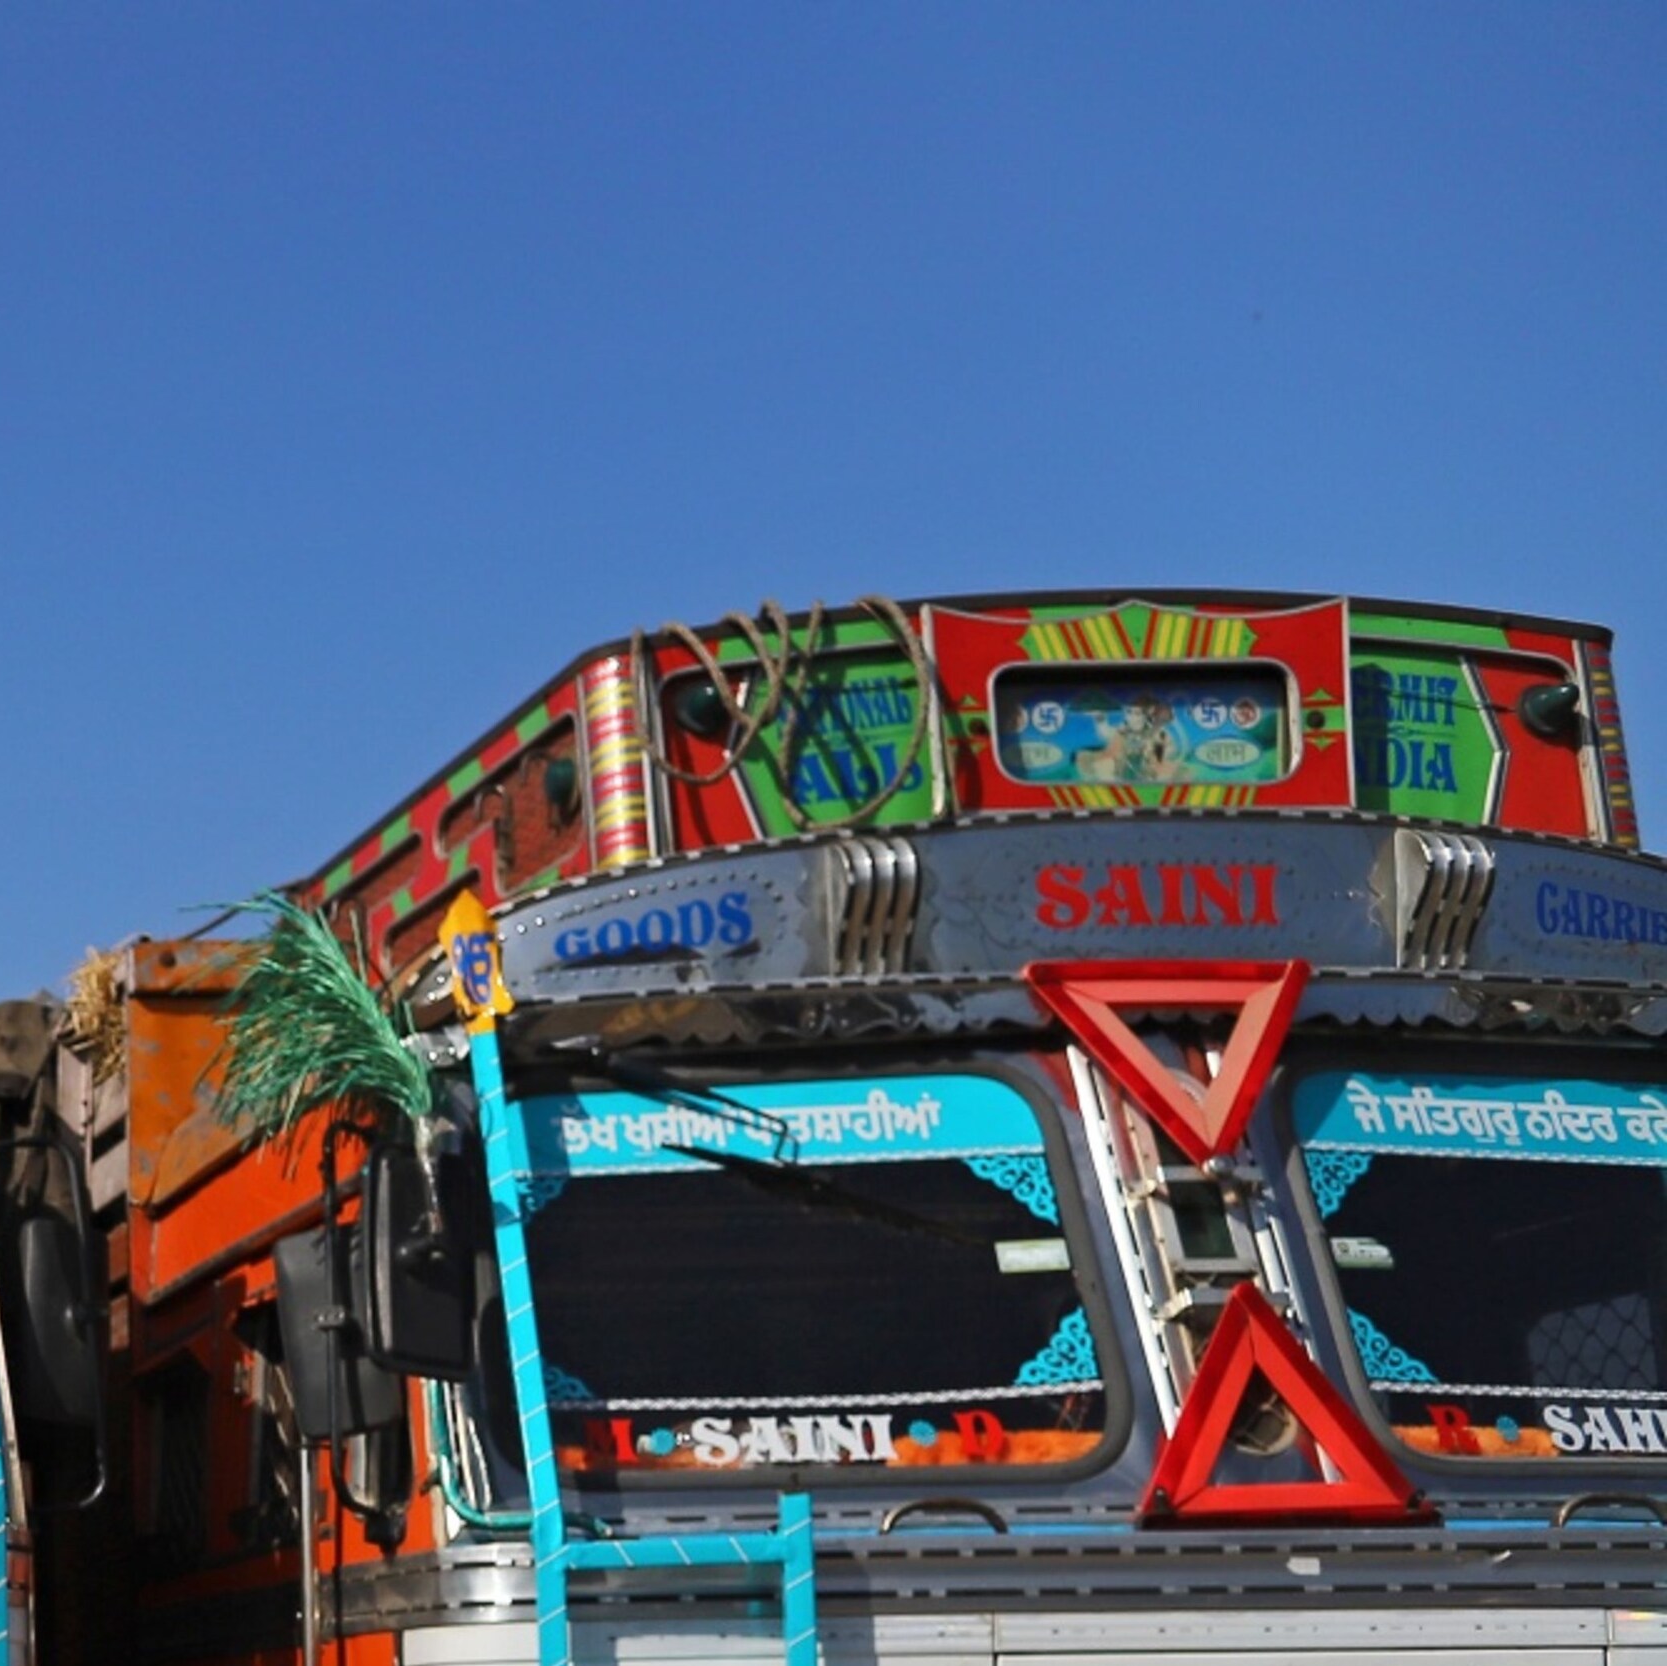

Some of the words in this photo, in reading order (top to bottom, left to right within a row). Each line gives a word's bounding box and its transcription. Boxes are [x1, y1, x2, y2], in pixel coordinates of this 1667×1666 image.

[554, 890, 753, 963] GOODS
[1034, 864, 1281, 930] SAINI
[692, 1413, 896, 1467] SAINI
[954, 1411, 1005, 1459] D
[1425, 1405, 1481, 1453] R
